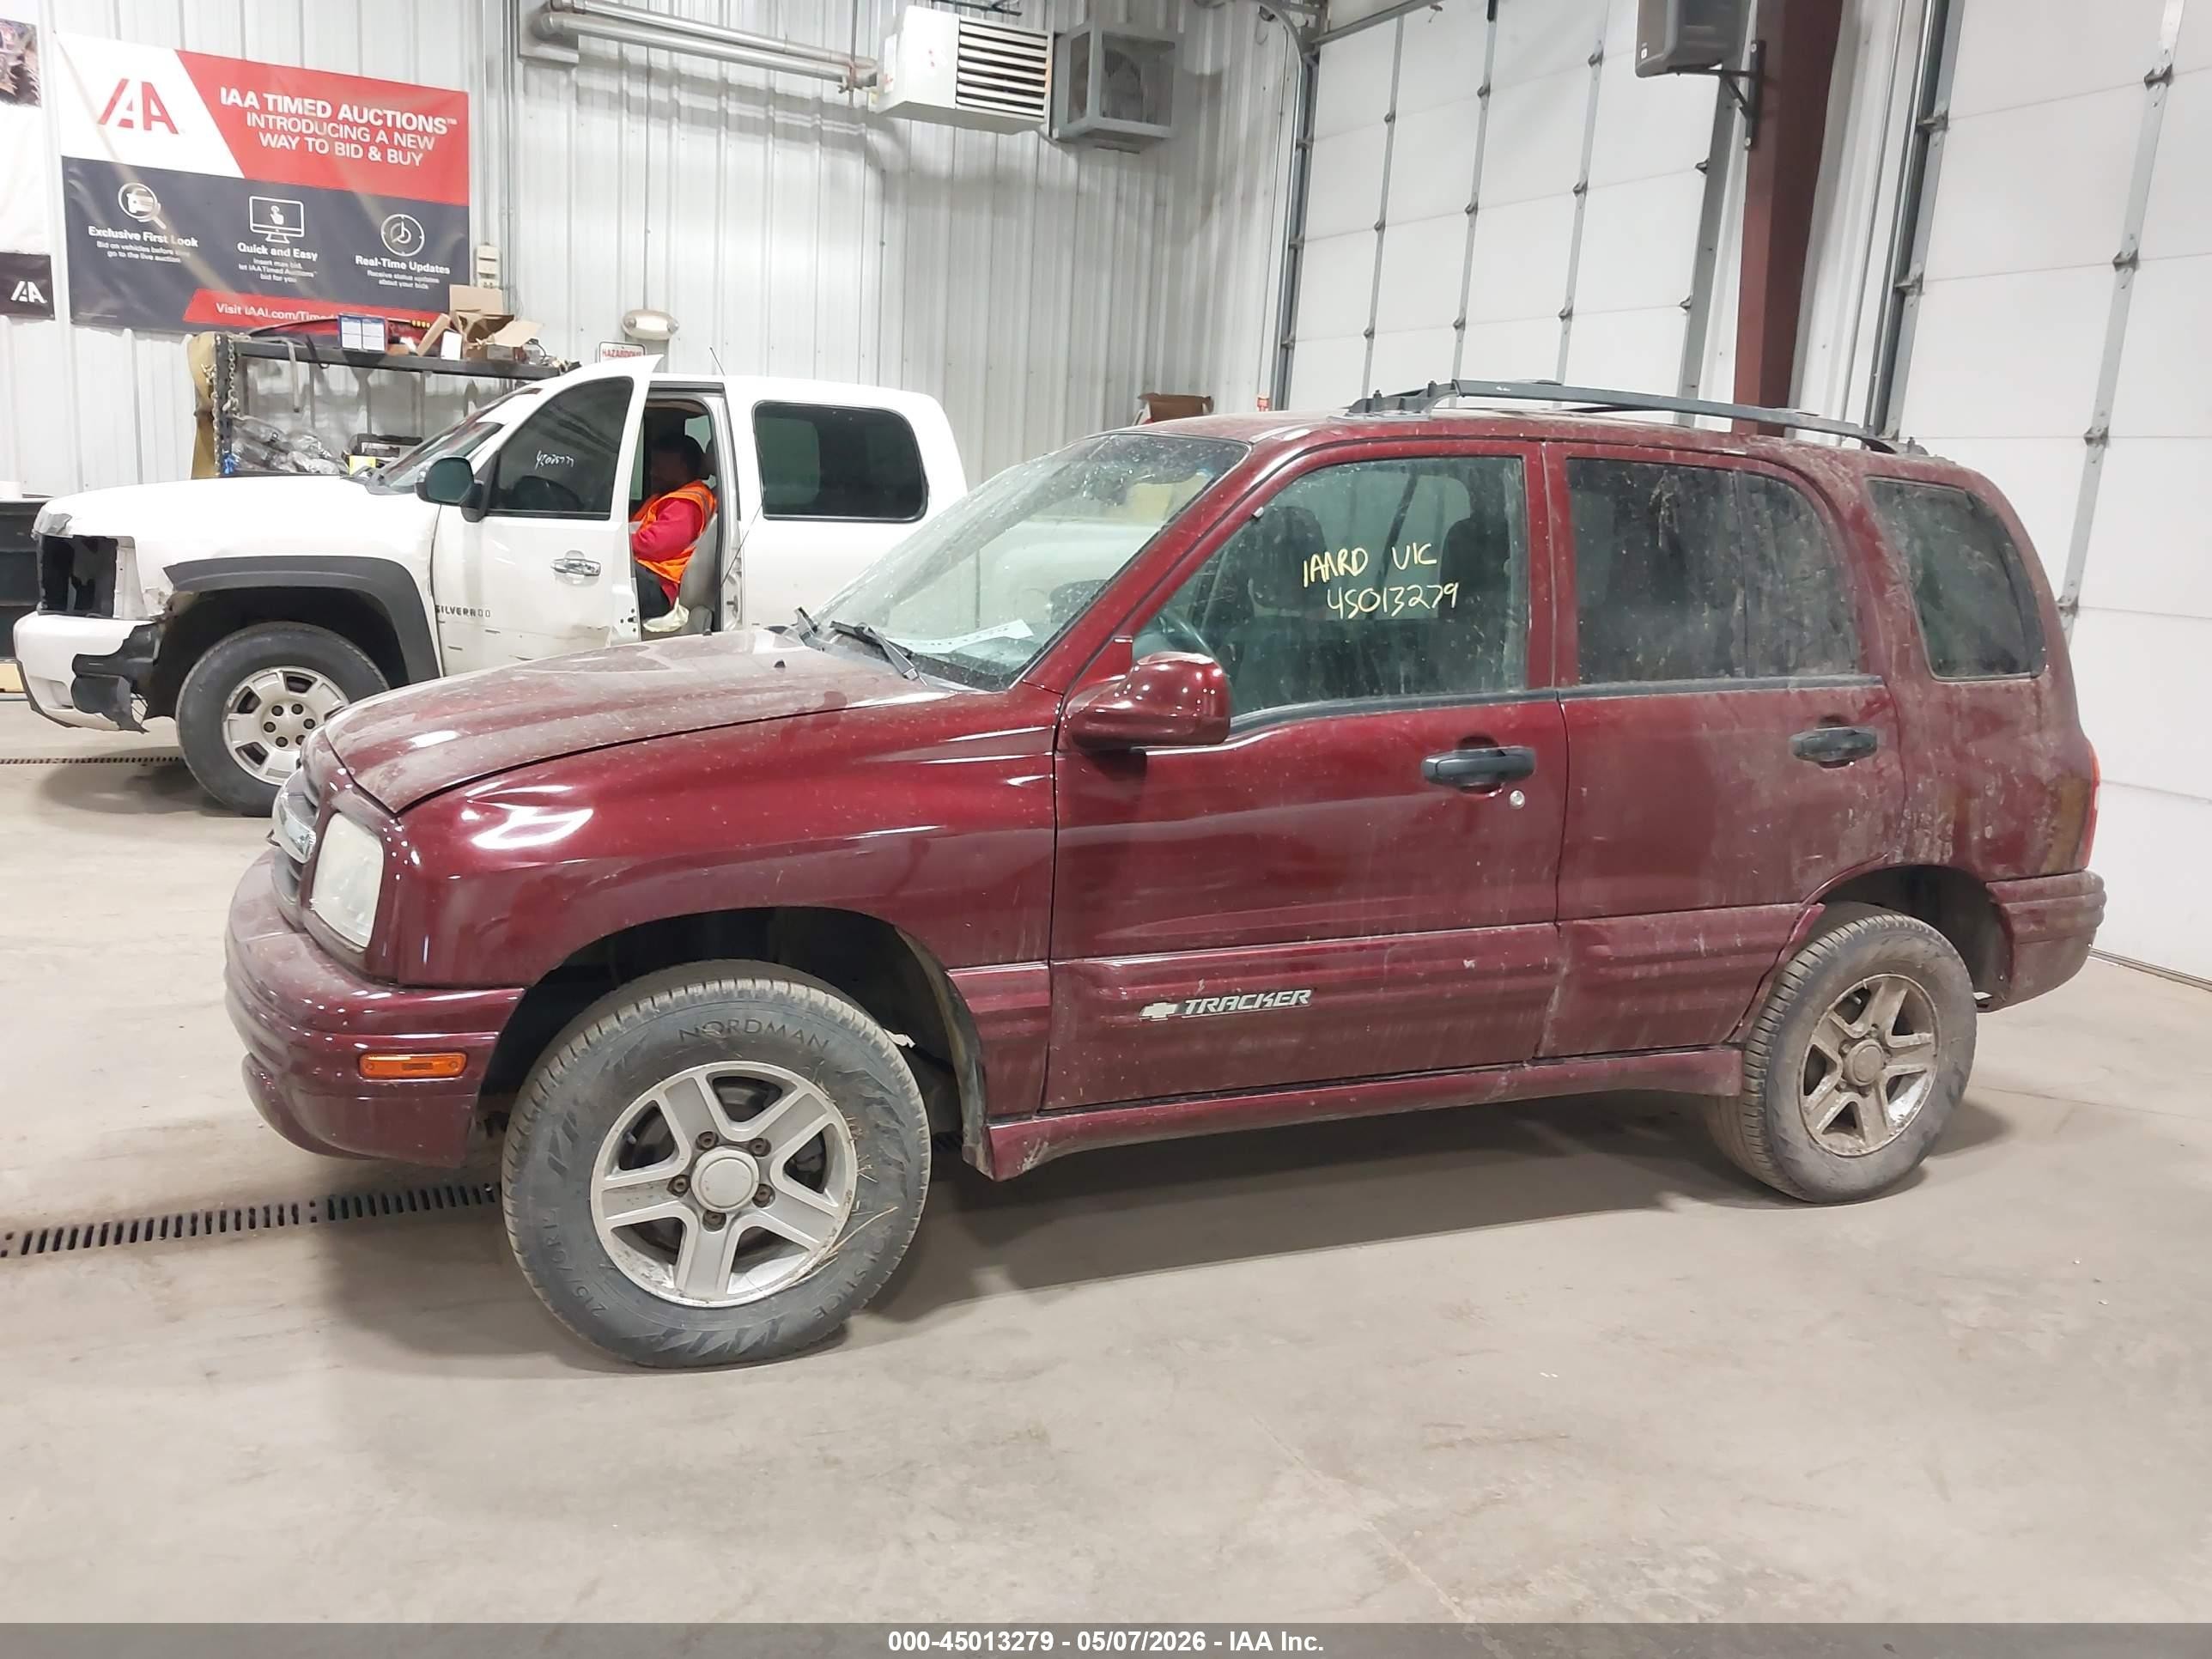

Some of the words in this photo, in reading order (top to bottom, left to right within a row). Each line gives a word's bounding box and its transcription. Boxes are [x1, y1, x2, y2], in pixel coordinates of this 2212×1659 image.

[220, 87, 260, 111] IAA
[263, 93, 332, 119] TIMED
[246, 112, 371, 143] INTRODUCING
[375, 129, 389, 144] A
[393, 132, 436, 151] NEW
[258, 131, 301, 151] WAY
[304, 137, 330, 155] TO
[334, 141, 364, 160] BID
[368, 145, 382, 162] &
[386, 149, 424, 167] BUY
[88, 226, 142, 241] Exclusive
[143, 231, 168, 245] First
[170, 234, 199, 248] Look
[237, 241, 269, 256] Quick
[270, 247, 291, 258] and
[293, 248, 319, 262] Easy
[355, 255, 407, 270] Real-Time
[409, 261, 451, 275] Updates
[216, 303, 242, 316] Visit
[434, 604, 492, 618] SILVERADO
[1326, 581, 1459, 620] 45013279
[1184, 988, 1312, 1015] TRACKER
[678, 1018, 830, 1051] NORDMAN
